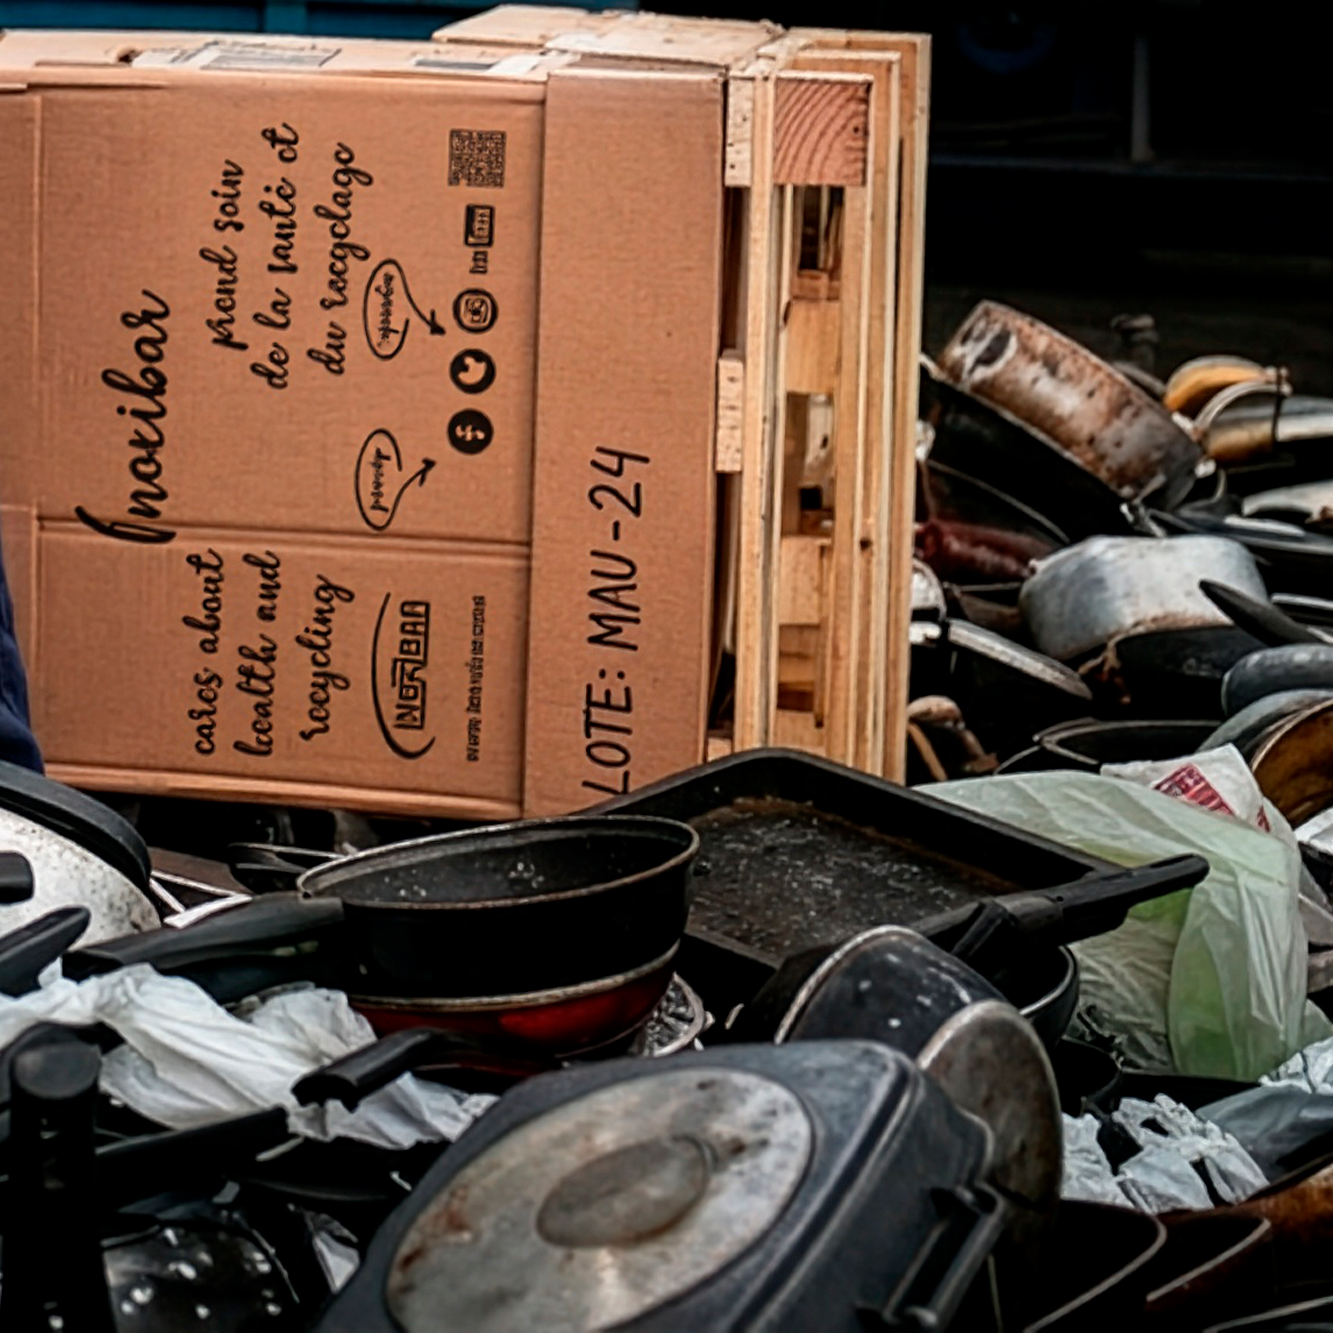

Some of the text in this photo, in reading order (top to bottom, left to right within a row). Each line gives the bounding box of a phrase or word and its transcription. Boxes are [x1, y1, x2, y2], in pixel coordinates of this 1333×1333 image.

[261, 123, 299, 163] et
[199, 160, 249, 351] prend soin
[253, 288, 291, 330] la
[73, 290, 175, 544] Inoxibar
[250, 342, 289, 389] de
[307, 322, 347, 375] du
[182, 549, 224, 755] cares about
[233, 551, 281, 756] health and
[295, 575, 355, 741] recycling
[582, 669, 636, 797] LOTE:
